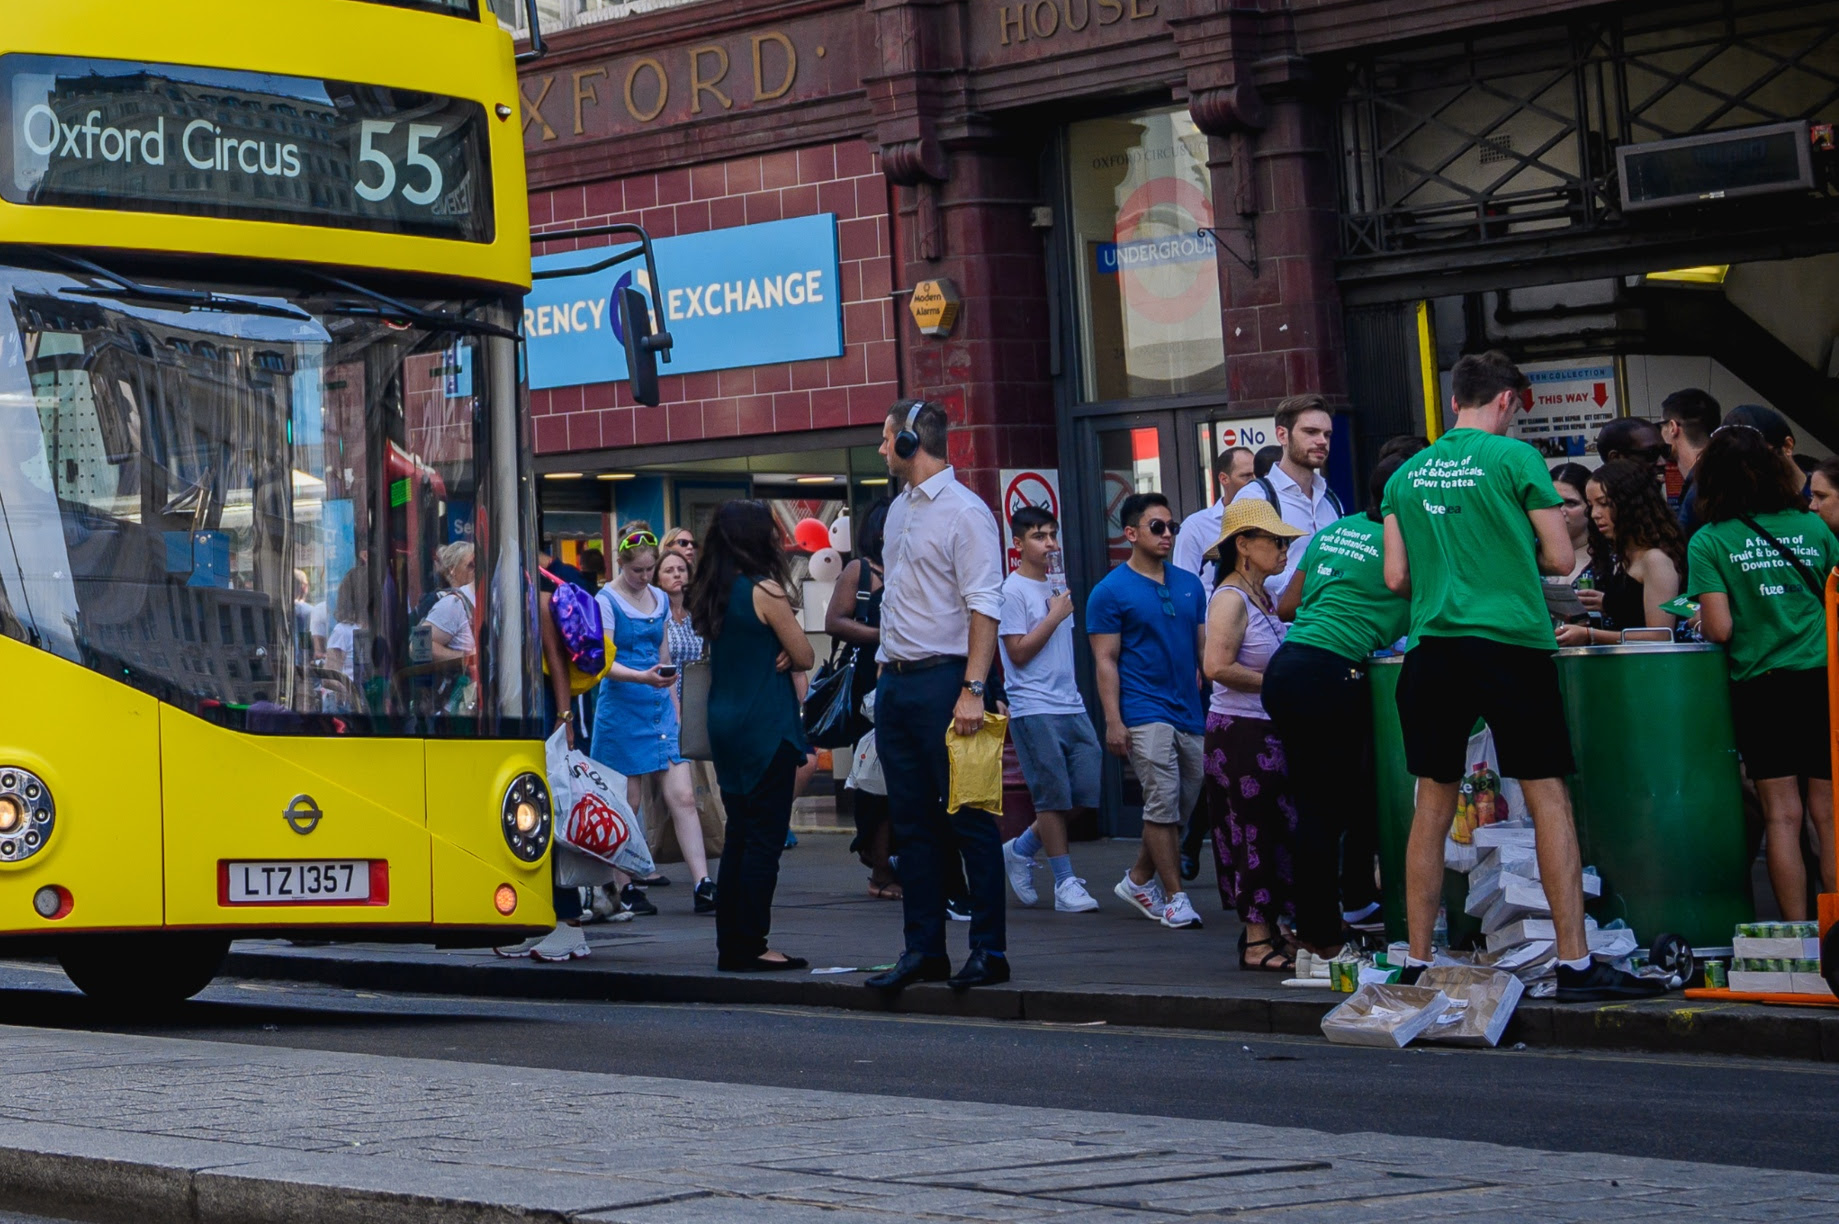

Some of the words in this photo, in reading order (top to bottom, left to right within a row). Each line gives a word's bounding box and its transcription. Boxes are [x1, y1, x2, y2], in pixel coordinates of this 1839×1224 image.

[521, 32, 797, 141] XFORD
[23, 104, 163, 166] Oxford
[182, 120, 302, 178] Circus
[354, 120, 444, 206] 55
[524, 298, 606, 338] RENCY
[668, 269, 824, 322] EXCHANGE
[914, 293, 942, 303] Modern
[916, 307, 940, 316] Alarms
[1549, 369, 1606, 380] COLLECTION
[1538, 394, 1563, 406] THIS
[1565, 392, 1590, 404] WAY
[1240, 427, 1265, 446] No
[1425, 458, 1433, 467] A
[1435, 458, 1458, 468] fuson
[1461, 455, 1473, 467] of
[1429, 468, 1438, 478] &
[1438, 466, 1486, 478] boanicals.
[1441, 479, 1451, 489] to
[1458, 479, 1477, 488] tea.
[1422, 499, 1463, 515] fuzeea
[453, 519, 475, 535] Se
[1335, 527, 1342, 535] A
[1341, 527, 1361, 539] fusion
[1360, 533, 1372, 542] of
[1334, 536, 1341, 544] &
[1340, 538, 1379, 558] botanicals.
[1746, 538, 1754, 548] A
[1755, 536, 1790, 547] fuon
[1792, 535, 1804, 545] of
[1319, 542, 1338, 554] Down
[1337, 547, 1345, 555] to
[1350, 551, 1366, 562] tea.
[1729, 550, 1754, 564] fruit
[1755, 547, 1764, 558] &
[1765, 545, 1820, 557] bonicals.
[1741, 560, 1771, 572] Down
[1771, 559, 1784, 568] to
[244, 867, 293, 896] LTZ
[299, 864, 354, 895] 1357
